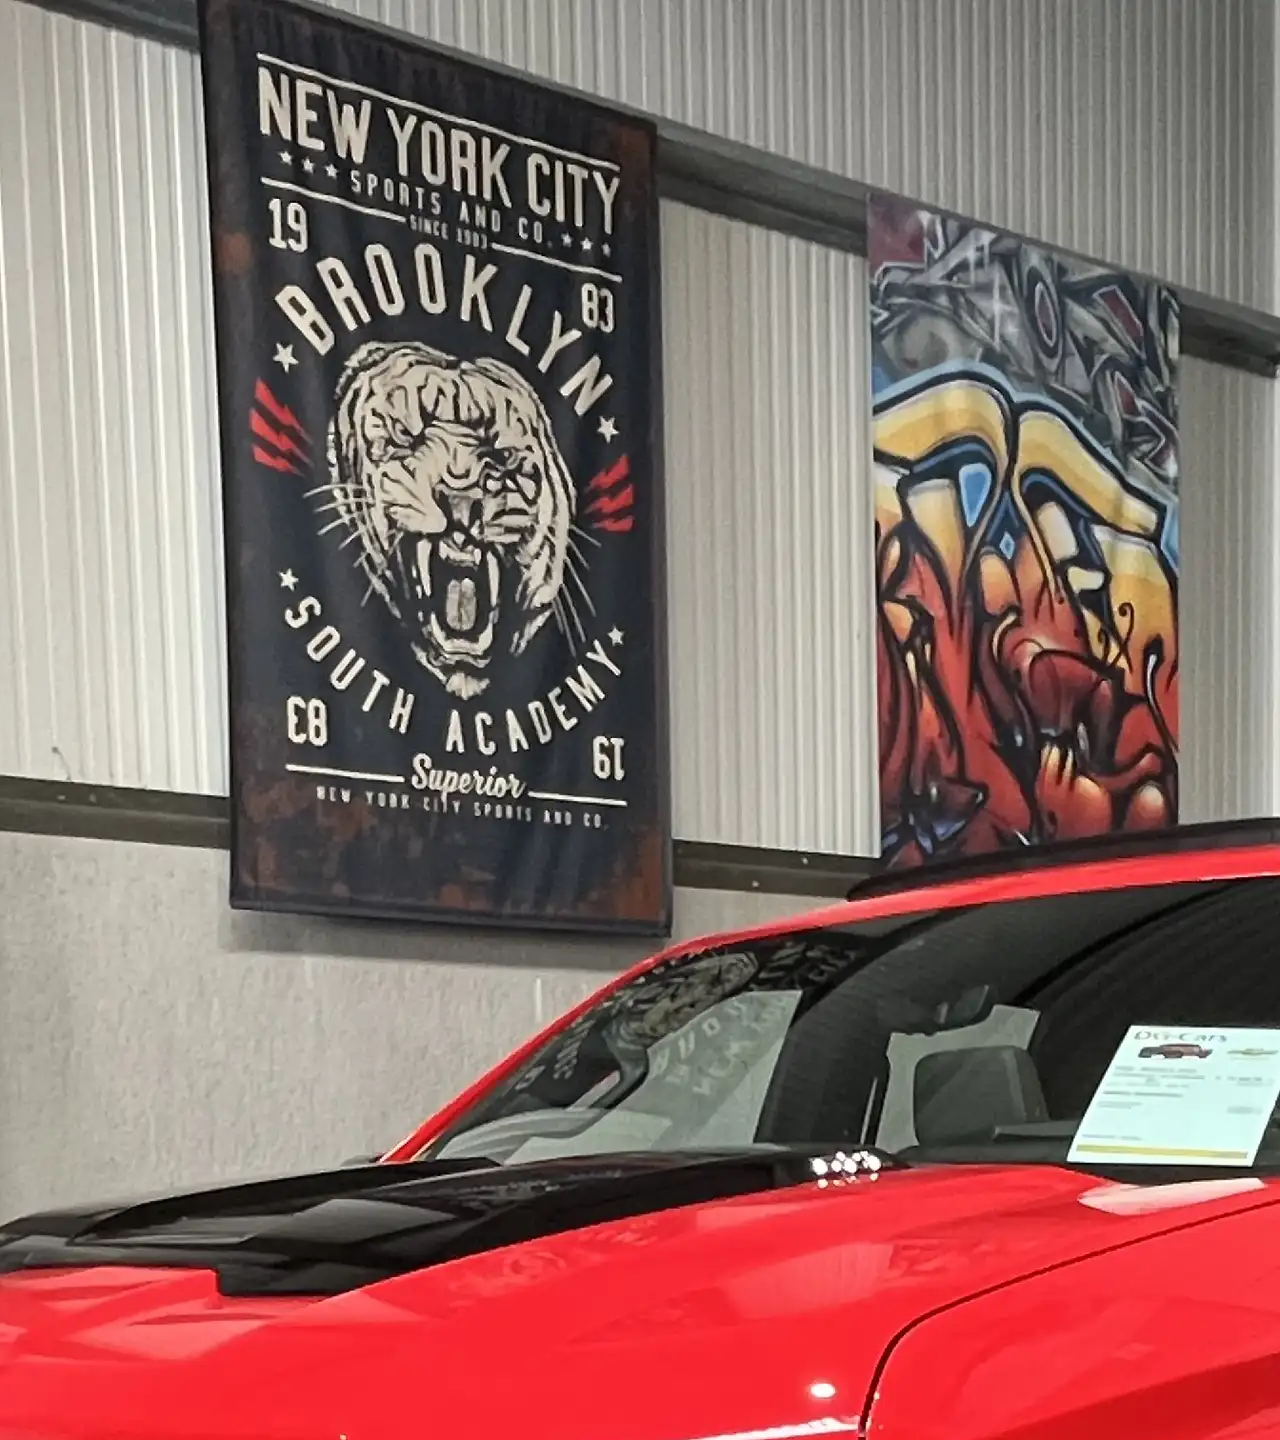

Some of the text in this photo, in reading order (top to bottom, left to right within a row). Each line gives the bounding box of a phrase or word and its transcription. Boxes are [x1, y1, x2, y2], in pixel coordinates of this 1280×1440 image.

[258, 67, 619, 235] NEW YORK CITY
[267, 198, 309, 253] 19
[349, 169, 553, 248] SPORTS AND CO.
[409, 214, 450, 241] SINCE
[274, 243, 614, 418] BROOKLYN
[581, 283, 615, 333] 83
[284, 595, 622, 756] SOUTH ACADEMY
[411, 752, 528, 803] Superior
[316, 785, 352, 805] NEW
[365, 790, 410, 811] YORK
[422, 794, 461, 816] CITY
[474, 803, 532, 823] SPORTS
[543, 809, 573, 827] AND
